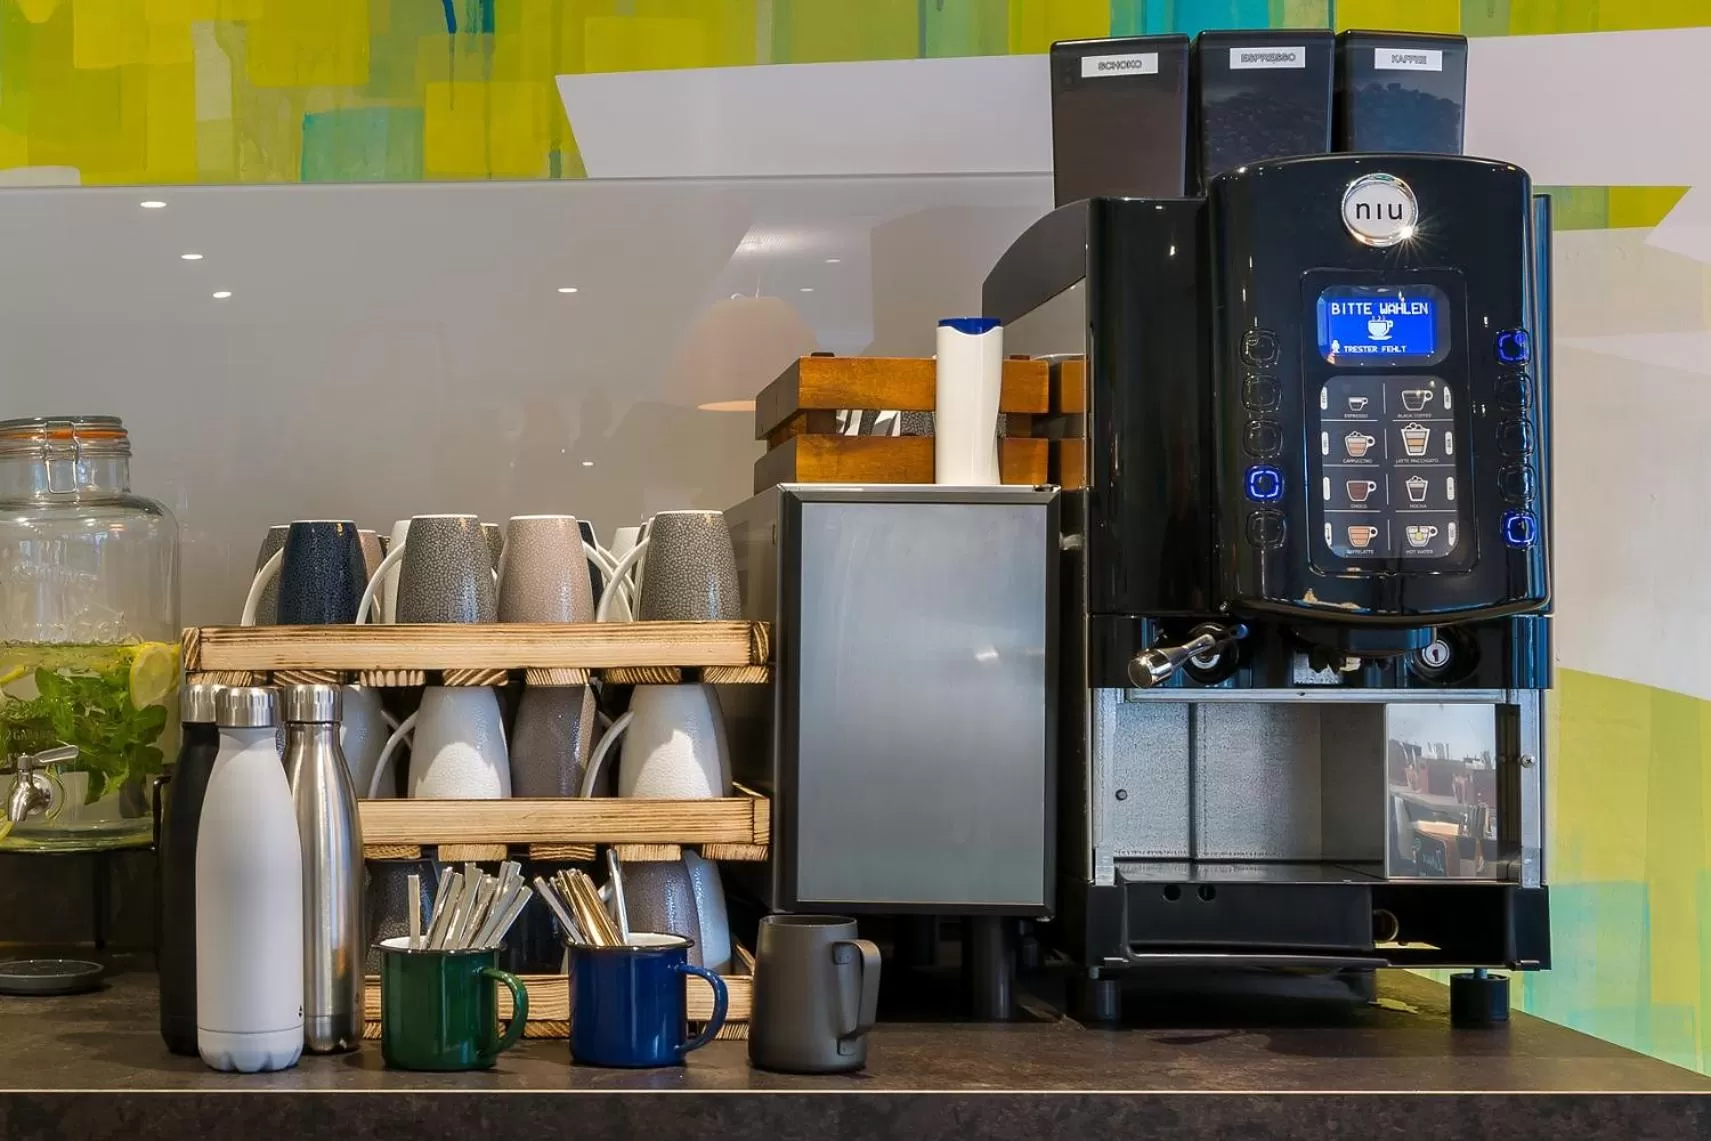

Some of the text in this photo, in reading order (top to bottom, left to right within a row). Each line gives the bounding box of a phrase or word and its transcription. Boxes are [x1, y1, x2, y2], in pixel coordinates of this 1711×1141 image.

[1240, 52, 1297, 63] ESPRESSO
[1098, 59, 1143, 71] SCHOKO
[1356, 203, 1402, 219] niu
[1331, 302, 1373, 315] BITTE
[1343, 345, 1407, 353] TRESTER FEHLT
